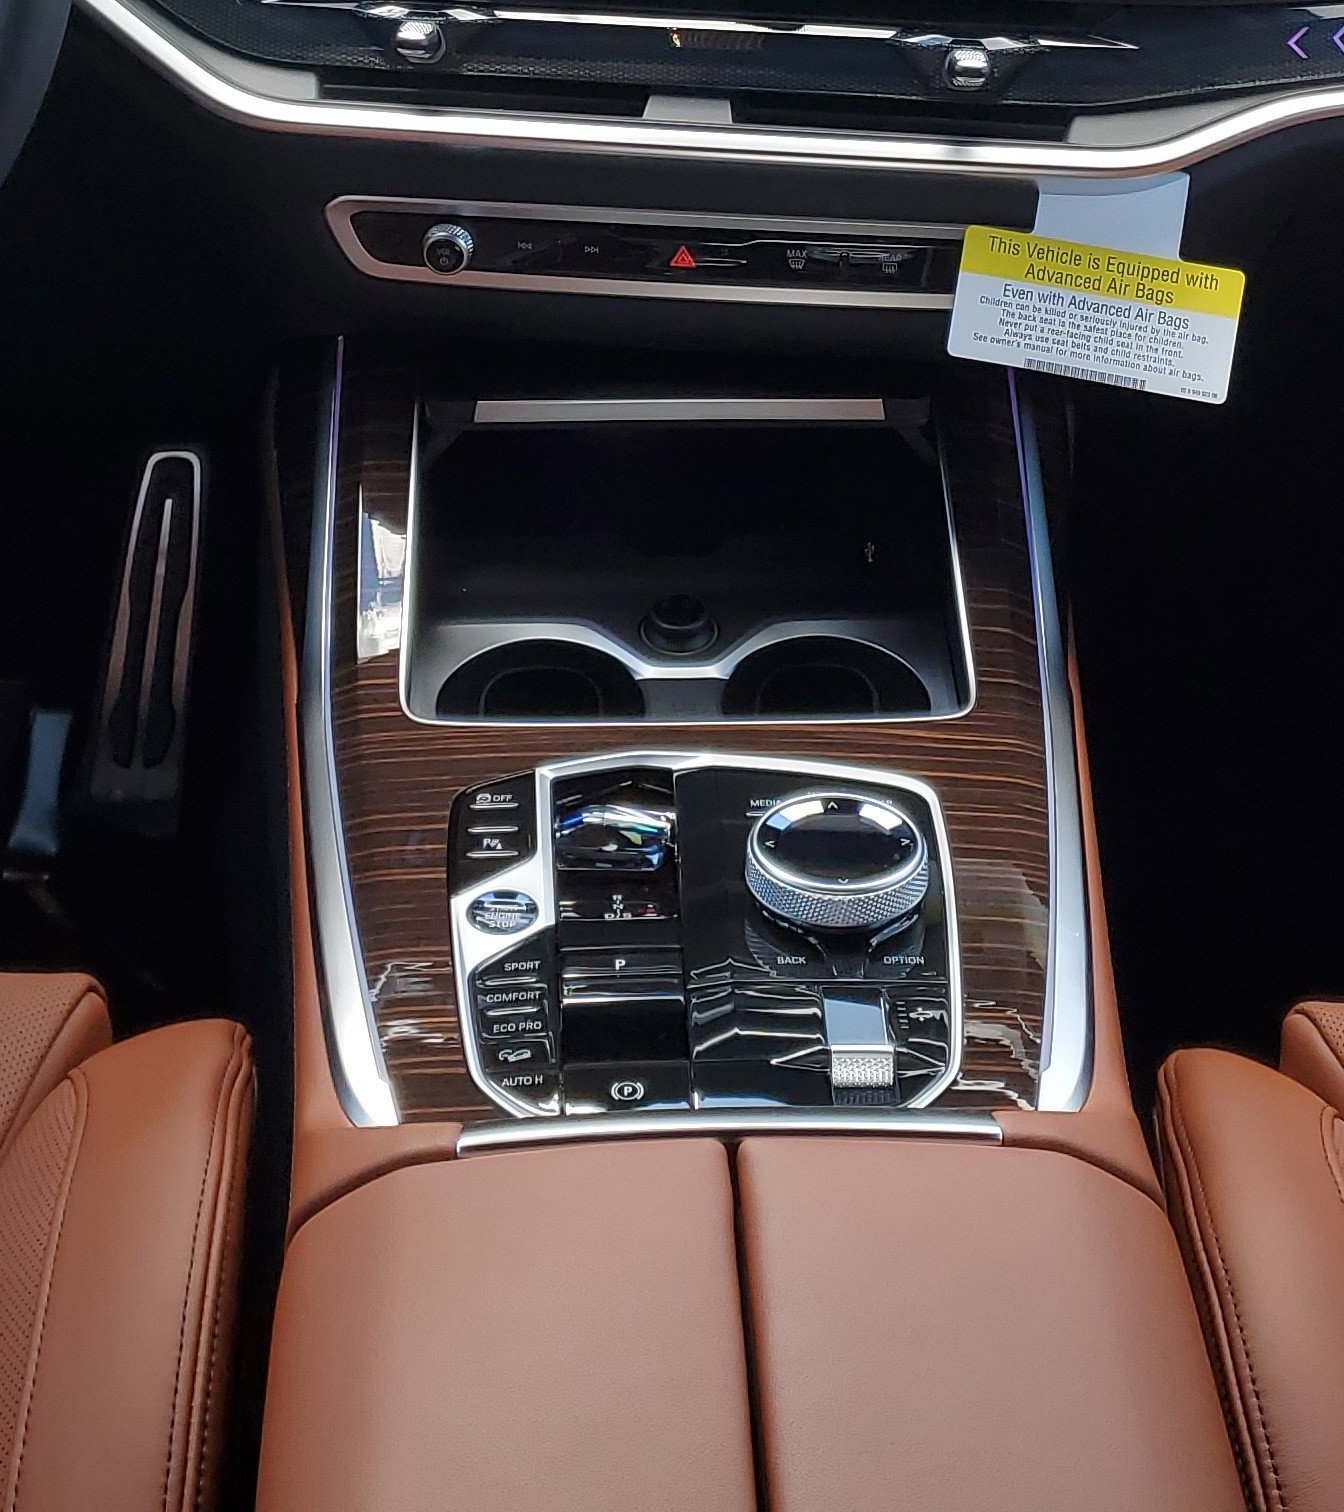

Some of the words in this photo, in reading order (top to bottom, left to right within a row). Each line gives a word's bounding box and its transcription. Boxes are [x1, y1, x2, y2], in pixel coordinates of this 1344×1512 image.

[786, 249, 808, 258] MAX
[988, 235, 1020, 256] This
[1026, 241, 1082, 267] Vehicle
[1087, 252, 1101, 269] is
[1105, 255, 1180, 284] Equipped
[1185, 271, 1219, 291] with
[1024, 263, 1102, 291] Advanced
[1106, 277, 1130, 295] Air
[1135, 281, 1174, 305] Bags
[1002, 283, 1034, 301] Even
[1037, 290, 1065, 307] with
[1068, 295, 1131, 319] Advanced
[1134, 307, 1154, 323] Air
[1157, 310, 1190, 330] Bags
[979, 295, 1013, 308] Children
[1015, 303, 1029, 311] can
[1032, 304, 1042, 313] be
[1044, 306, 1066, 318] killed
[1068, 312, 1077, 320] or
[1079, 314, 1117, 328] seriously
[1119, 319, 1148, 333] injured
[1150, 325, 1160, 336] by
[1163, 328, 1176, 337] the
[1178, 331, 1190, 340] air
[1191, 332, 1208, 345] bag.
[1001, 308, 1015, 318] The
[1018, 311, 1036, 322] back
[1039, 316, 1056, 326] seat
[1058, 318, 1066, 327] is
[1068, 321, 1081, 330] the
[1083, 324, 1108, 335] safest
[1110, 328, 1132, 339] place
[1134, 332, 1146, 342] for
[1148, 335, 1184, 349] children.
[998, 317, 1022, 329] Never
[1024, 323, 1037, 332] put
[1047, 327, 1091, 343] rear-facing
[1093, 335, 1114, 346] child
[1116, 340, 1133, 349] seat
[1135, 342, 1143, 351] in
[1146, 344, 1158, 354] the
[1161, 347, 1183, 358] front.
[1004, 328, 1032, 341] Always
[1035, 334, 1049, 343] use
[1051, 338, 1068, 347] seat
[1071, 340, 1091, 351] belts
[1093, 345, 1108, 354] and
[1110, 348, 1131, 359] child
[1133, 352, 1175, 367] restraints.
[972, 332, 987, 342] See
[989, 336, 1021, 348] owner's
[1023, 342, 1053, 353] manual
[1055, 347, 1067, 356] for
[1069, 350, 1091, 361] more
[1093, 354, 1141, 370] information
[1142, 363, 1167, 374] about
[1168, 368, 1180, 376] air
[1181, 369, 1204, 381] bags.
[492, 794, 513, 802] OFF
[503, 960, 541, 972] SPORT
[615, 958, 626, 970] P
[777, 956, 807, 965] BACK
[883, 955, 925, 965] OPTION
[486, 990, 542, 1003] COMFORT
[493, 1023, 516, 1033] ECO
[518, 1020, 542, 1031] PRO
[501, 1076, 533, 1087] AUTO
[534, 1074, 544, 1085] H
